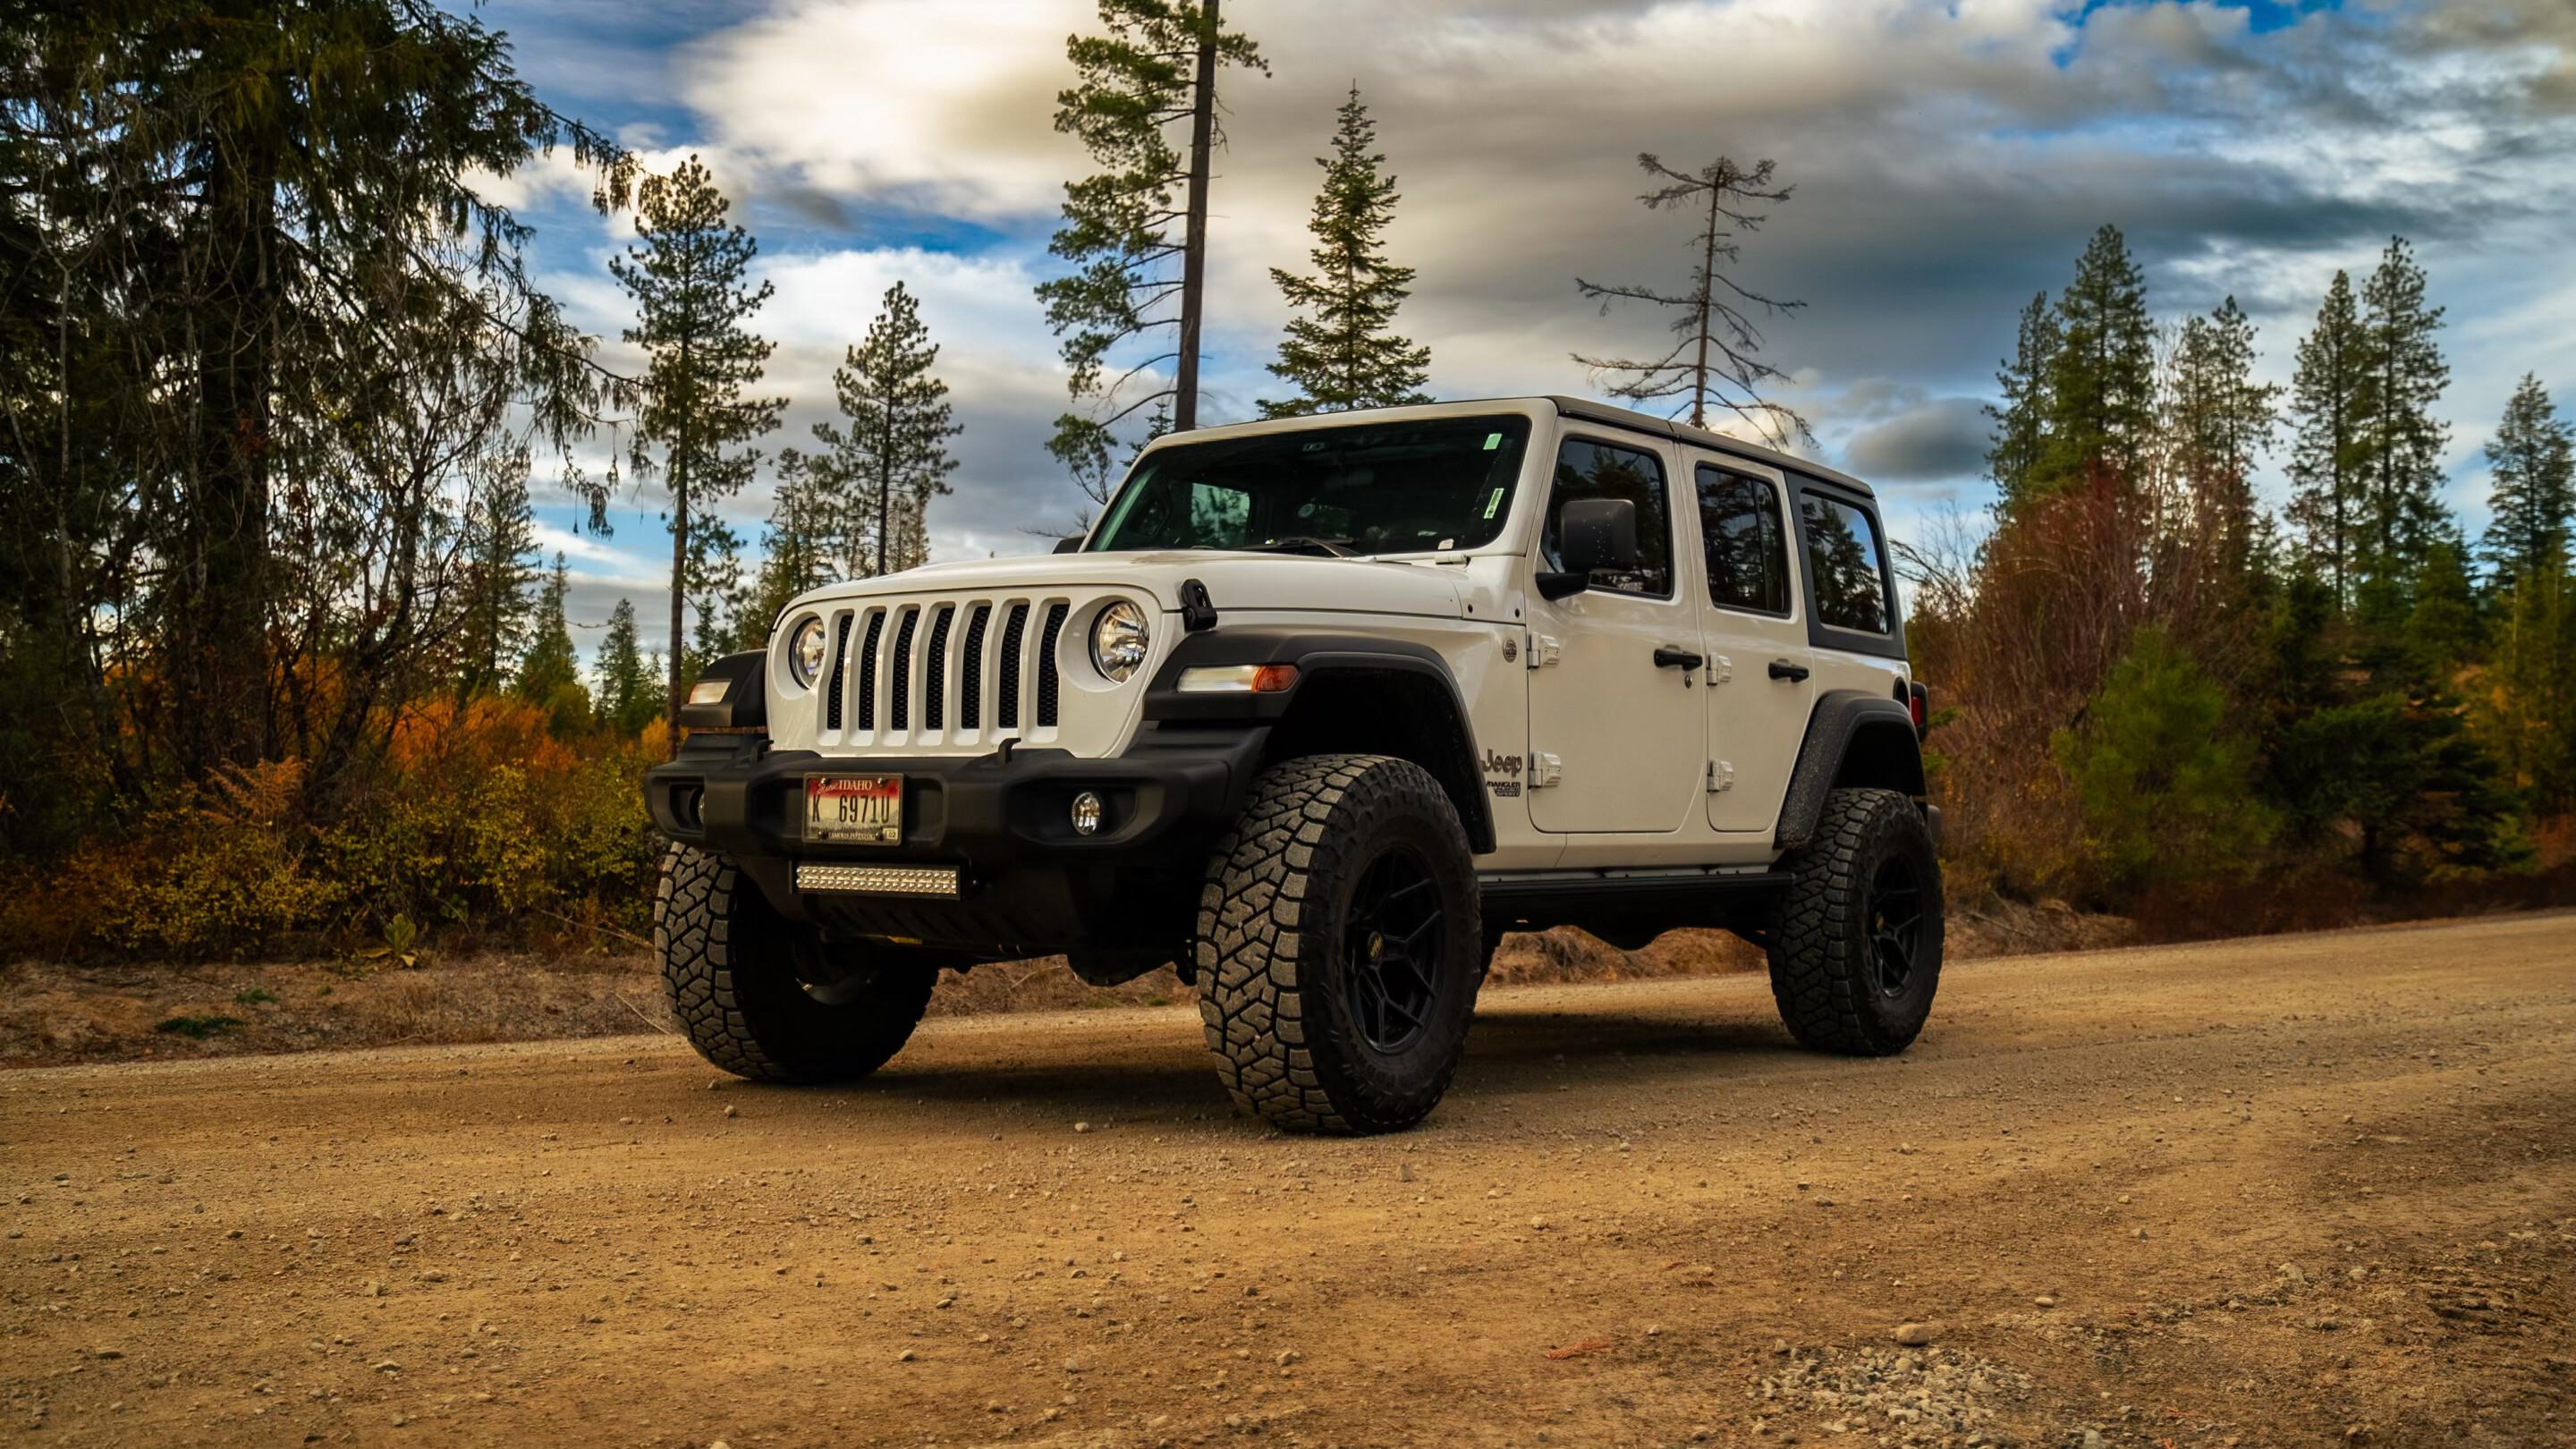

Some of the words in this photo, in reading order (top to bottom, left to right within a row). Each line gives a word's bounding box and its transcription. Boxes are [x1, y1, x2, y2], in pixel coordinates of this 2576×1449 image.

[1480, 749, 1522, 778] Jeep
[838, 780, 873, 790] IDAHO
[812, 794, 820, 823] K
[839, 794, 890, 824] 6971U
